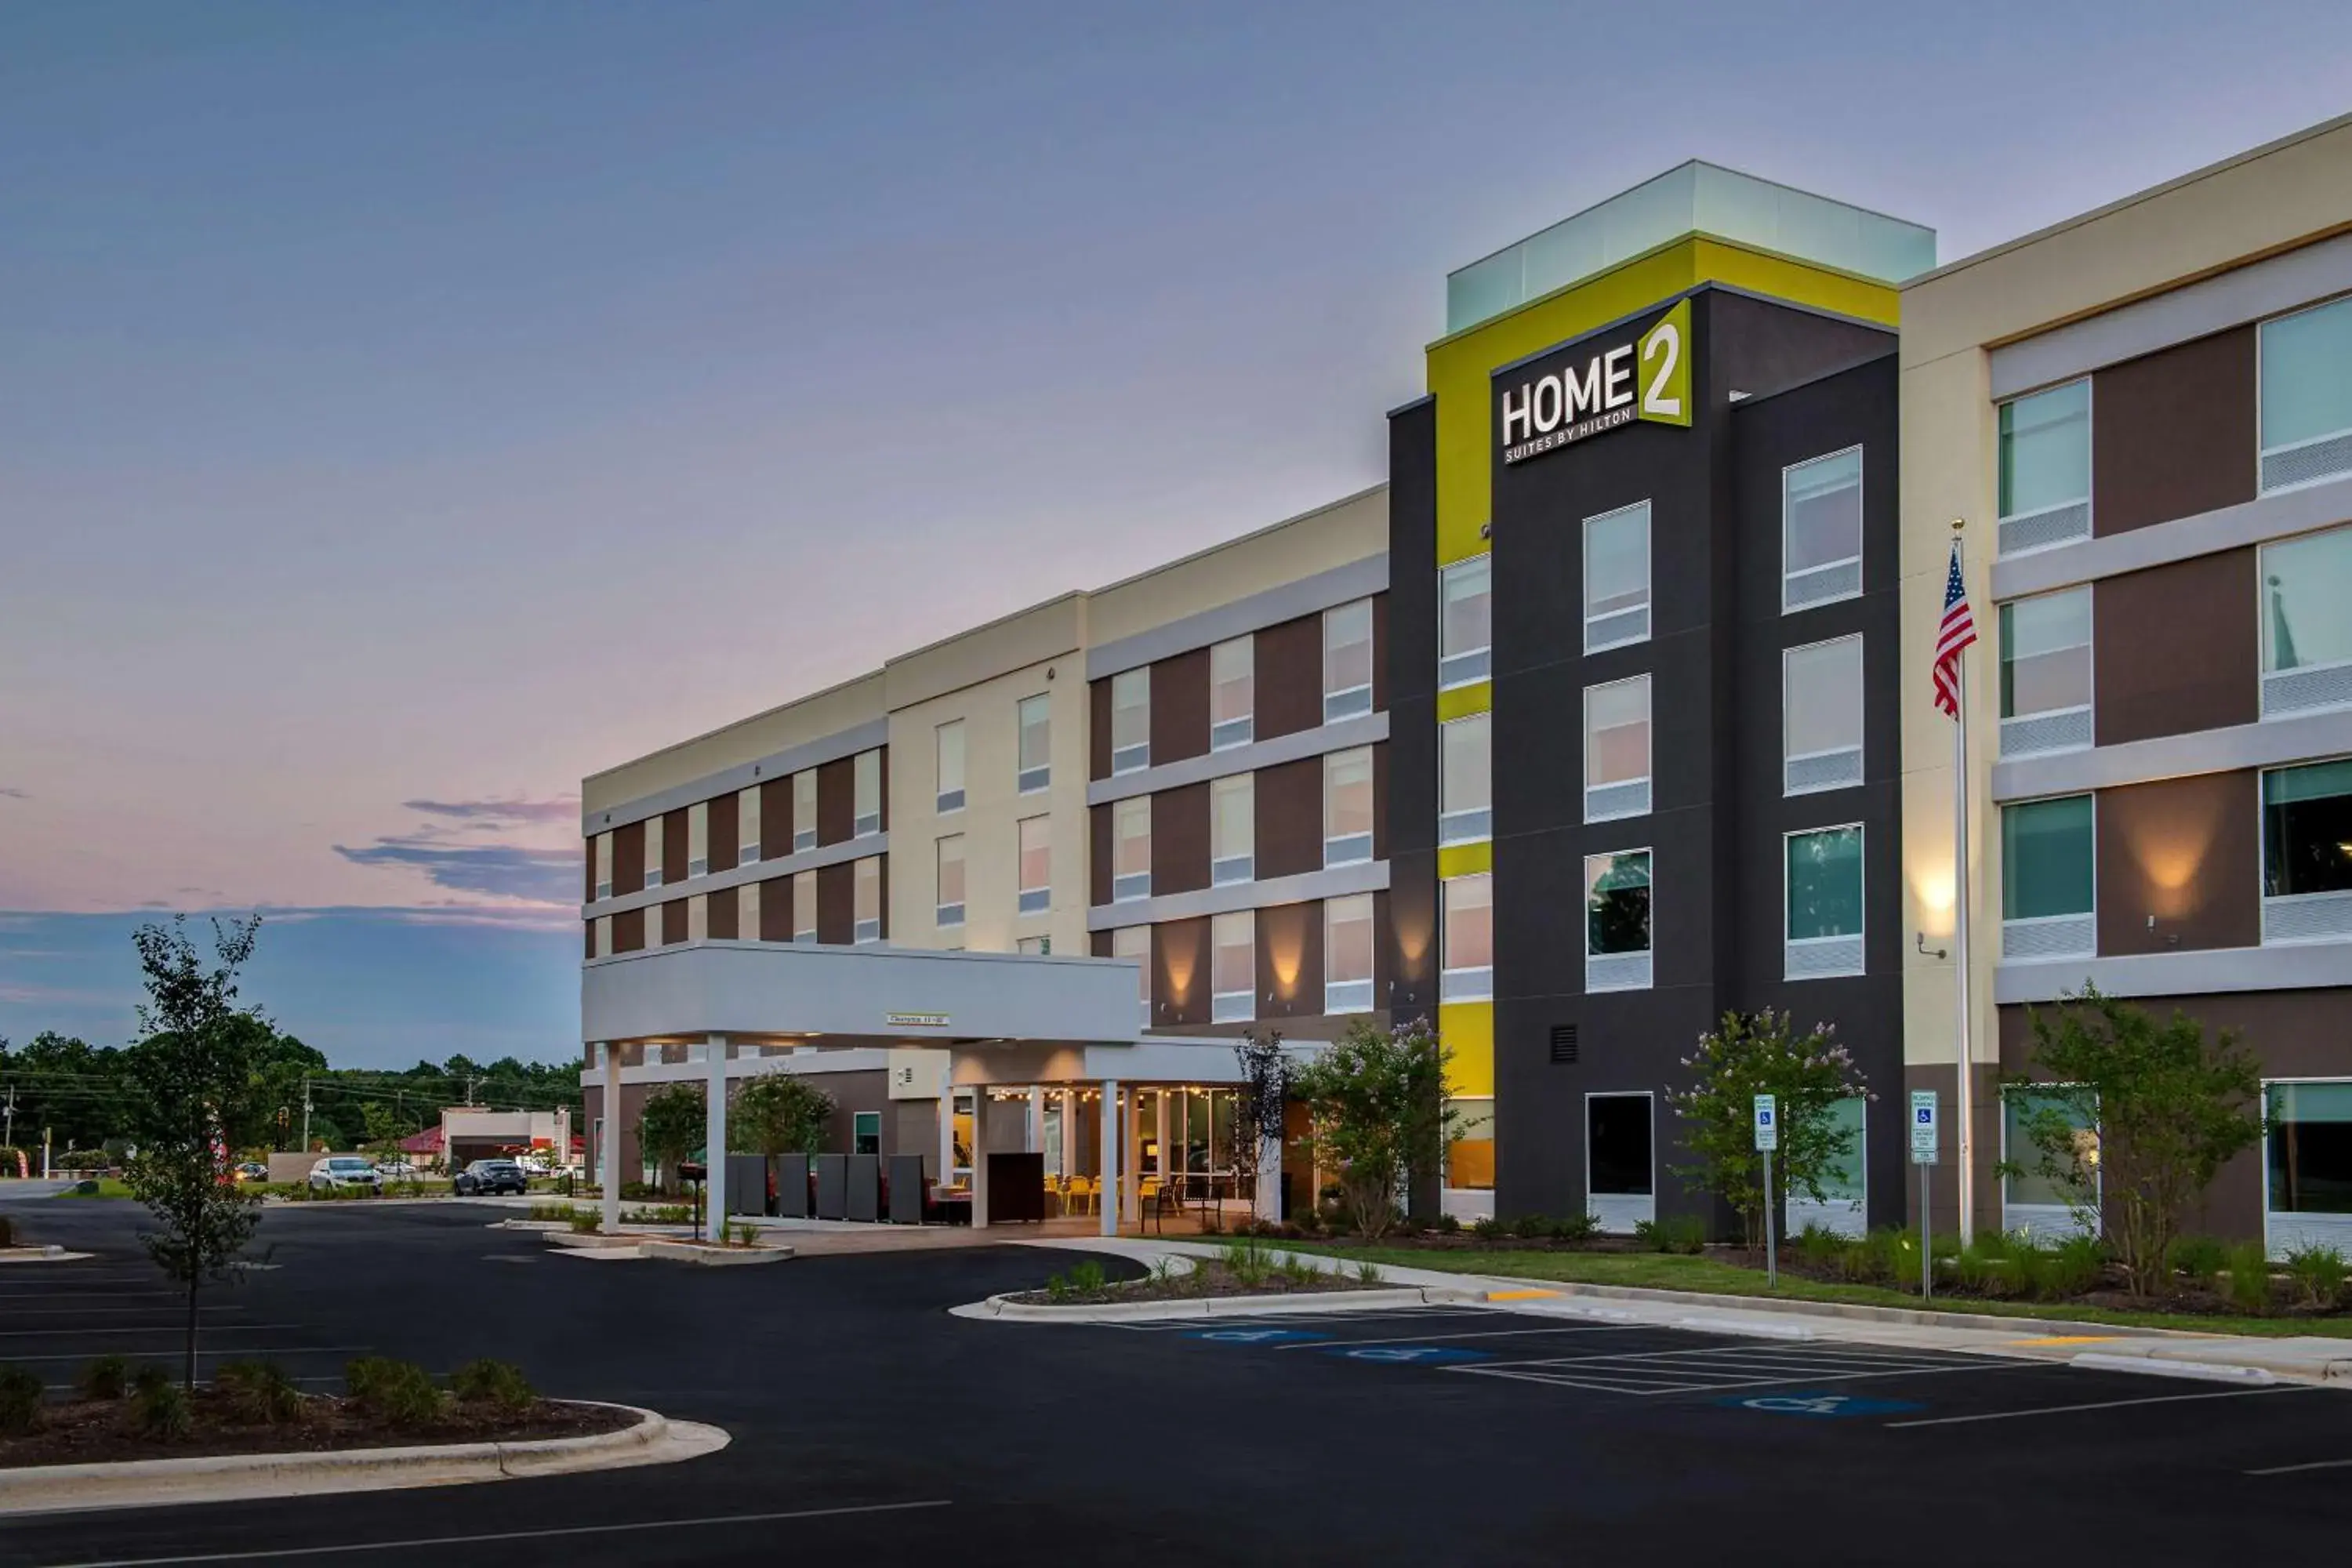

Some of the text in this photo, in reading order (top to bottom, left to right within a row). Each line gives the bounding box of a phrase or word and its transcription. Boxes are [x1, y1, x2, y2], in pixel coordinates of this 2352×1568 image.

[1503, 324, 1681, 446] HOME 2
[1505, 409, 1632, 463] SUITES BY HILTON
